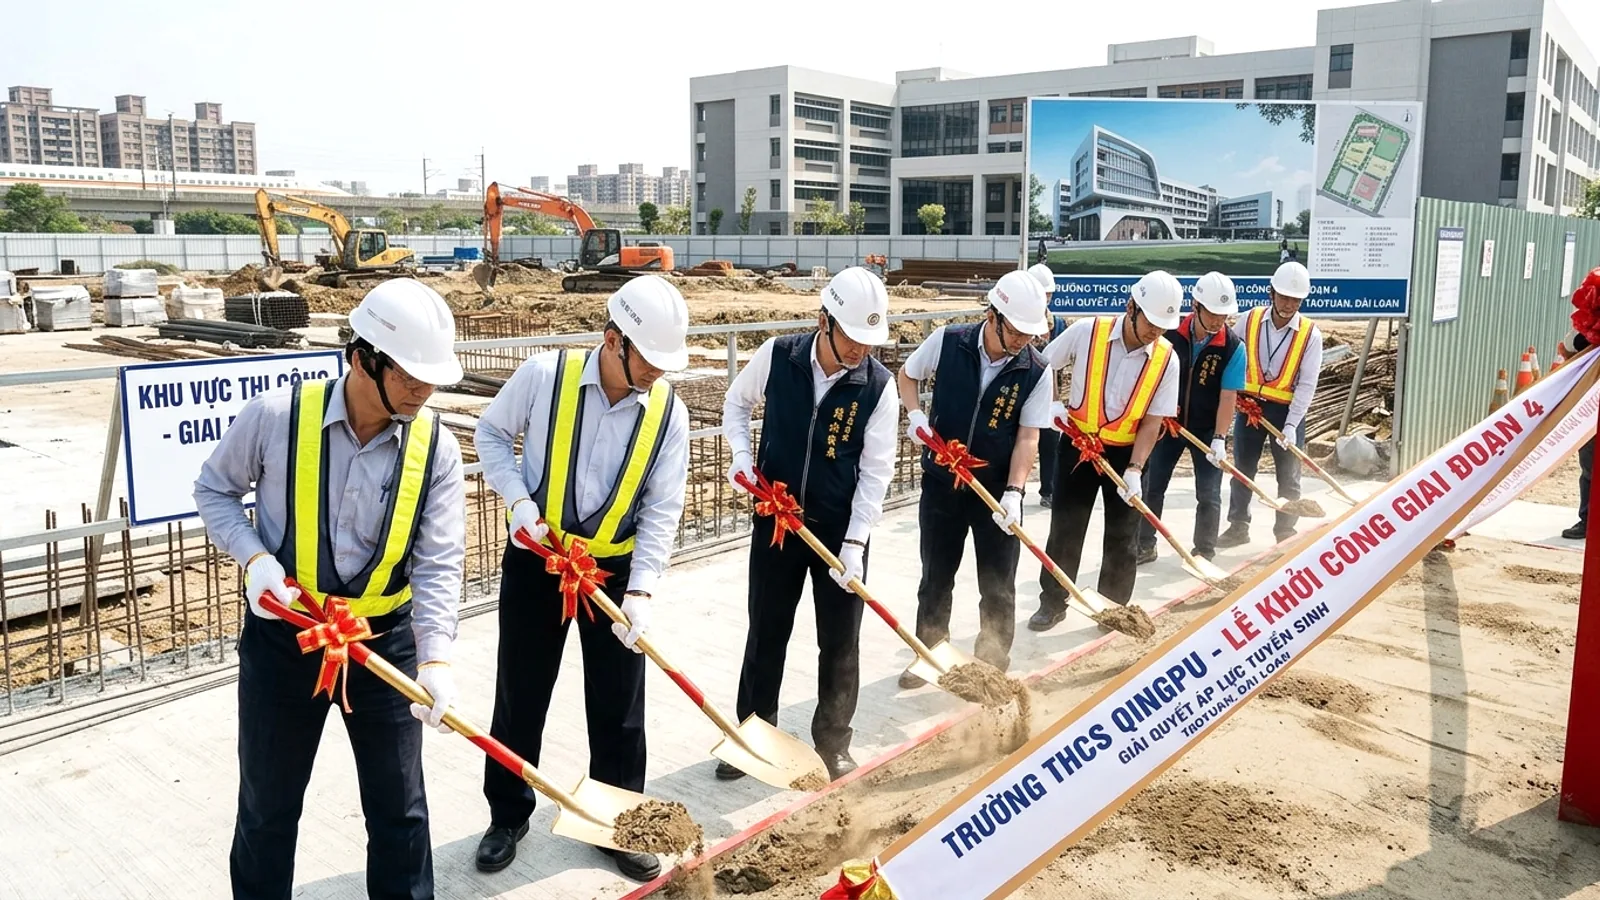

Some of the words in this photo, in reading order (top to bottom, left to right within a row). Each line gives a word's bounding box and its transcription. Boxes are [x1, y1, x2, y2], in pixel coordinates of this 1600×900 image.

[1092, 284, 1118, 293] THCS
[138, 382, 183, 410] KHU
[190, 376, 232, 409] VỰC
[238, 375, 270, 400] THI
[179, 416, 222, 445] GIAI
[941, 773, 1047, 859] TRƯỜNG
[1041, 723, 1113, 783] THCS
[1110, 651, 1208, 733] QINGPU
[1221, 606, 1261, 651] LỄ
[1255, 566, 1324, 625] KHỞI
[1319, 514, 1396, 577] CÔNG
[1391, 471, 1452, 522] GIAI
[1445, 414, 1523, 481] ĐOẠN
[1523, 399, 1544, 419] 4
[1149, 702, 1194, 741] QUYẾT
[1216, 665, 1246, 692] LỰC
[1293, 601, 1330, 634] SINH
